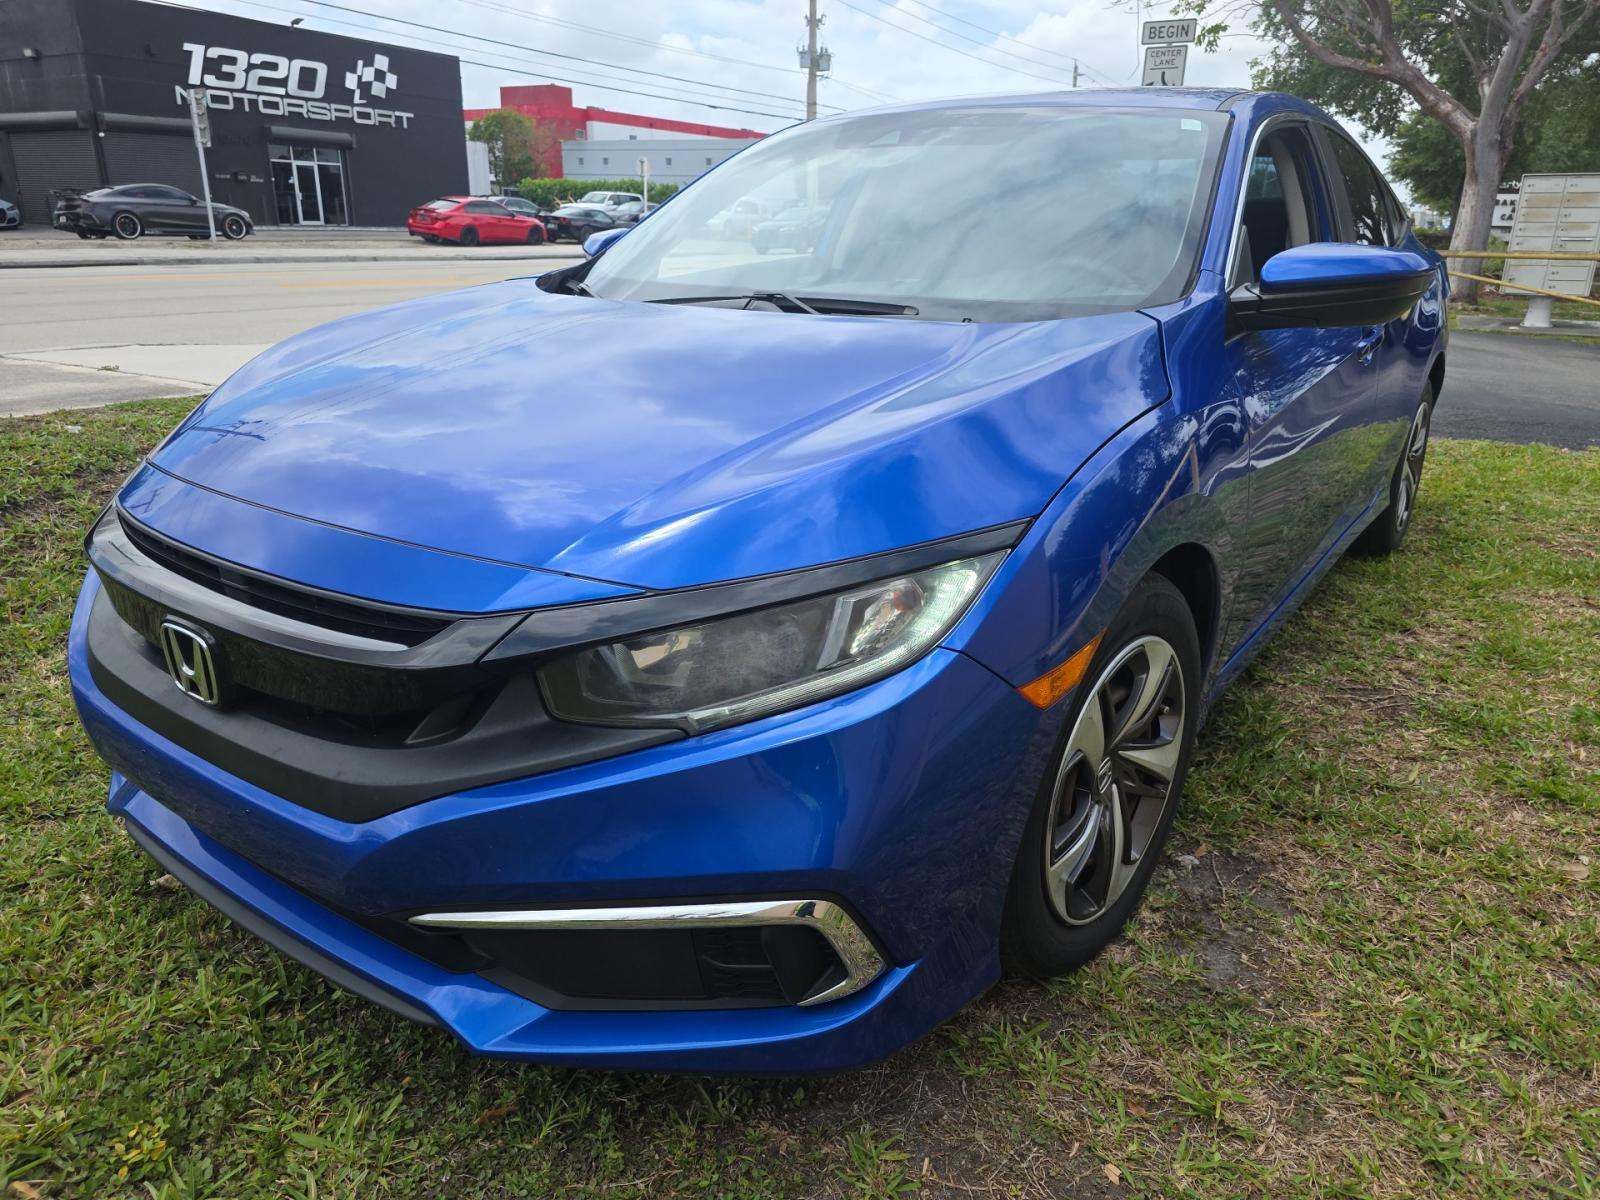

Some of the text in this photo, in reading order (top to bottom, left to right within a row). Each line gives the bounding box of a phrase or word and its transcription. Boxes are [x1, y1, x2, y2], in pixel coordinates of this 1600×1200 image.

[1149, 24, 1190, 39] BEGIN
[1150, 49, 1182, 58] CENTER
[1154, 59, 1176, 67] LANE
[183, 42, 328, 99] 1320
